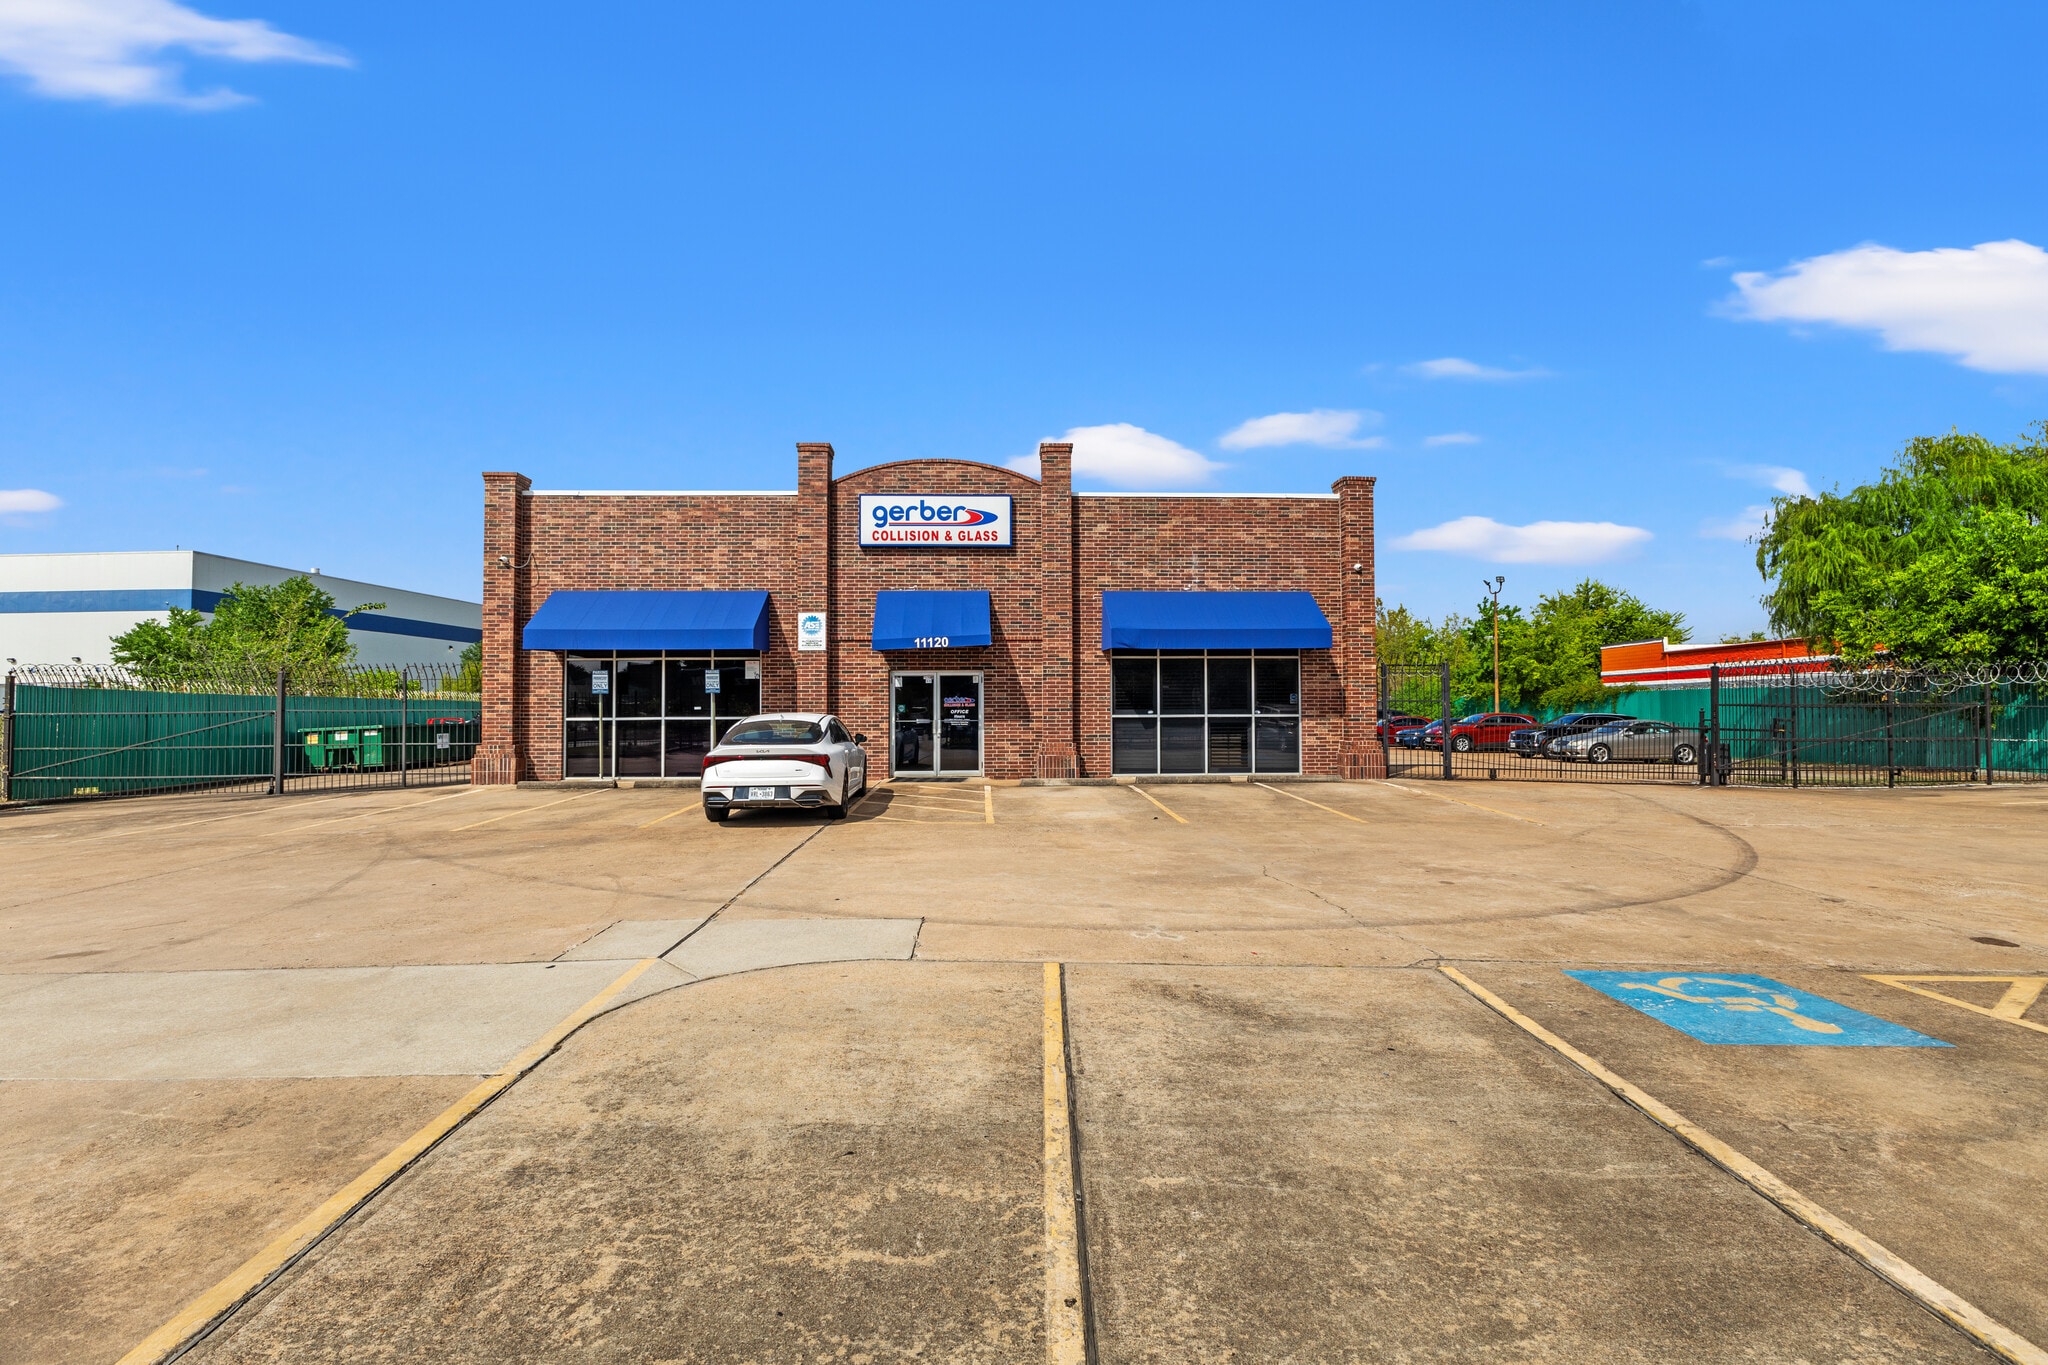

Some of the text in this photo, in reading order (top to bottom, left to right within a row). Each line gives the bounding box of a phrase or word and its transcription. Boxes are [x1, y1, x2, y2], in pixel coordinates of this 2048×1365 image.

[872, 500, 966, 528] gerber
[872, 530, 998, 542] COLLISION & GLASS
[914, 636, 949, 648] 11120
